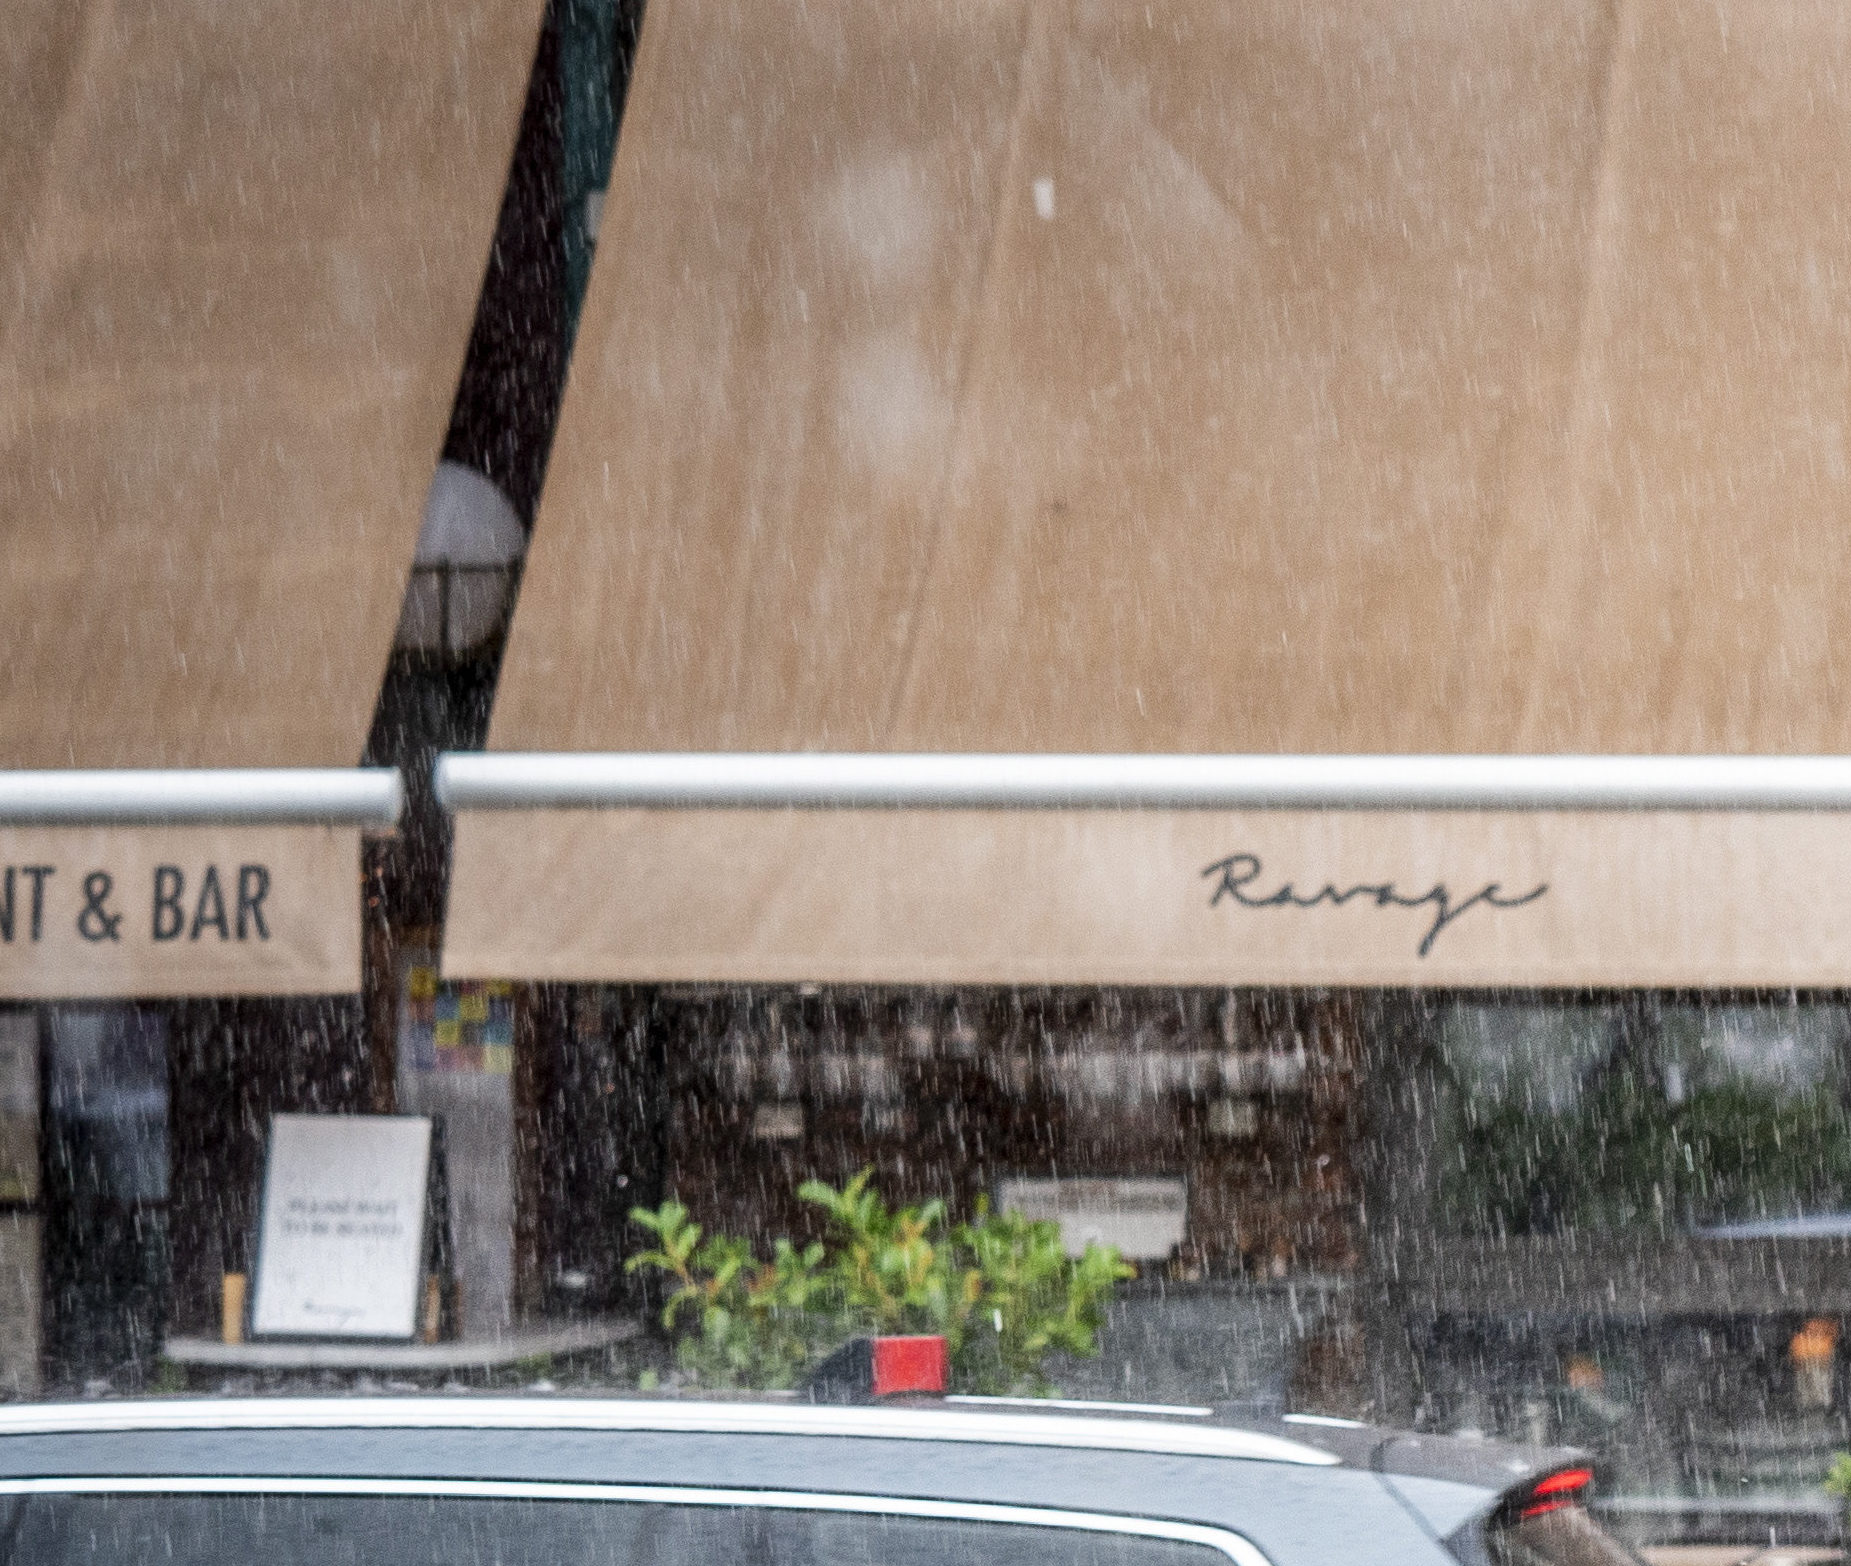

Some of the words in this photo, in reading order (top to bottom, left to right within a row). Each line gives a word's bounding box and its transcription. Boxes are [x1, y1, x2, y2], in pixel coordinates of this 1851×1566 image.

[77, 869, 123, 944] &
[152, 864, 271, 943] BAR
[1200, 853, 1550, 958] Ravage
